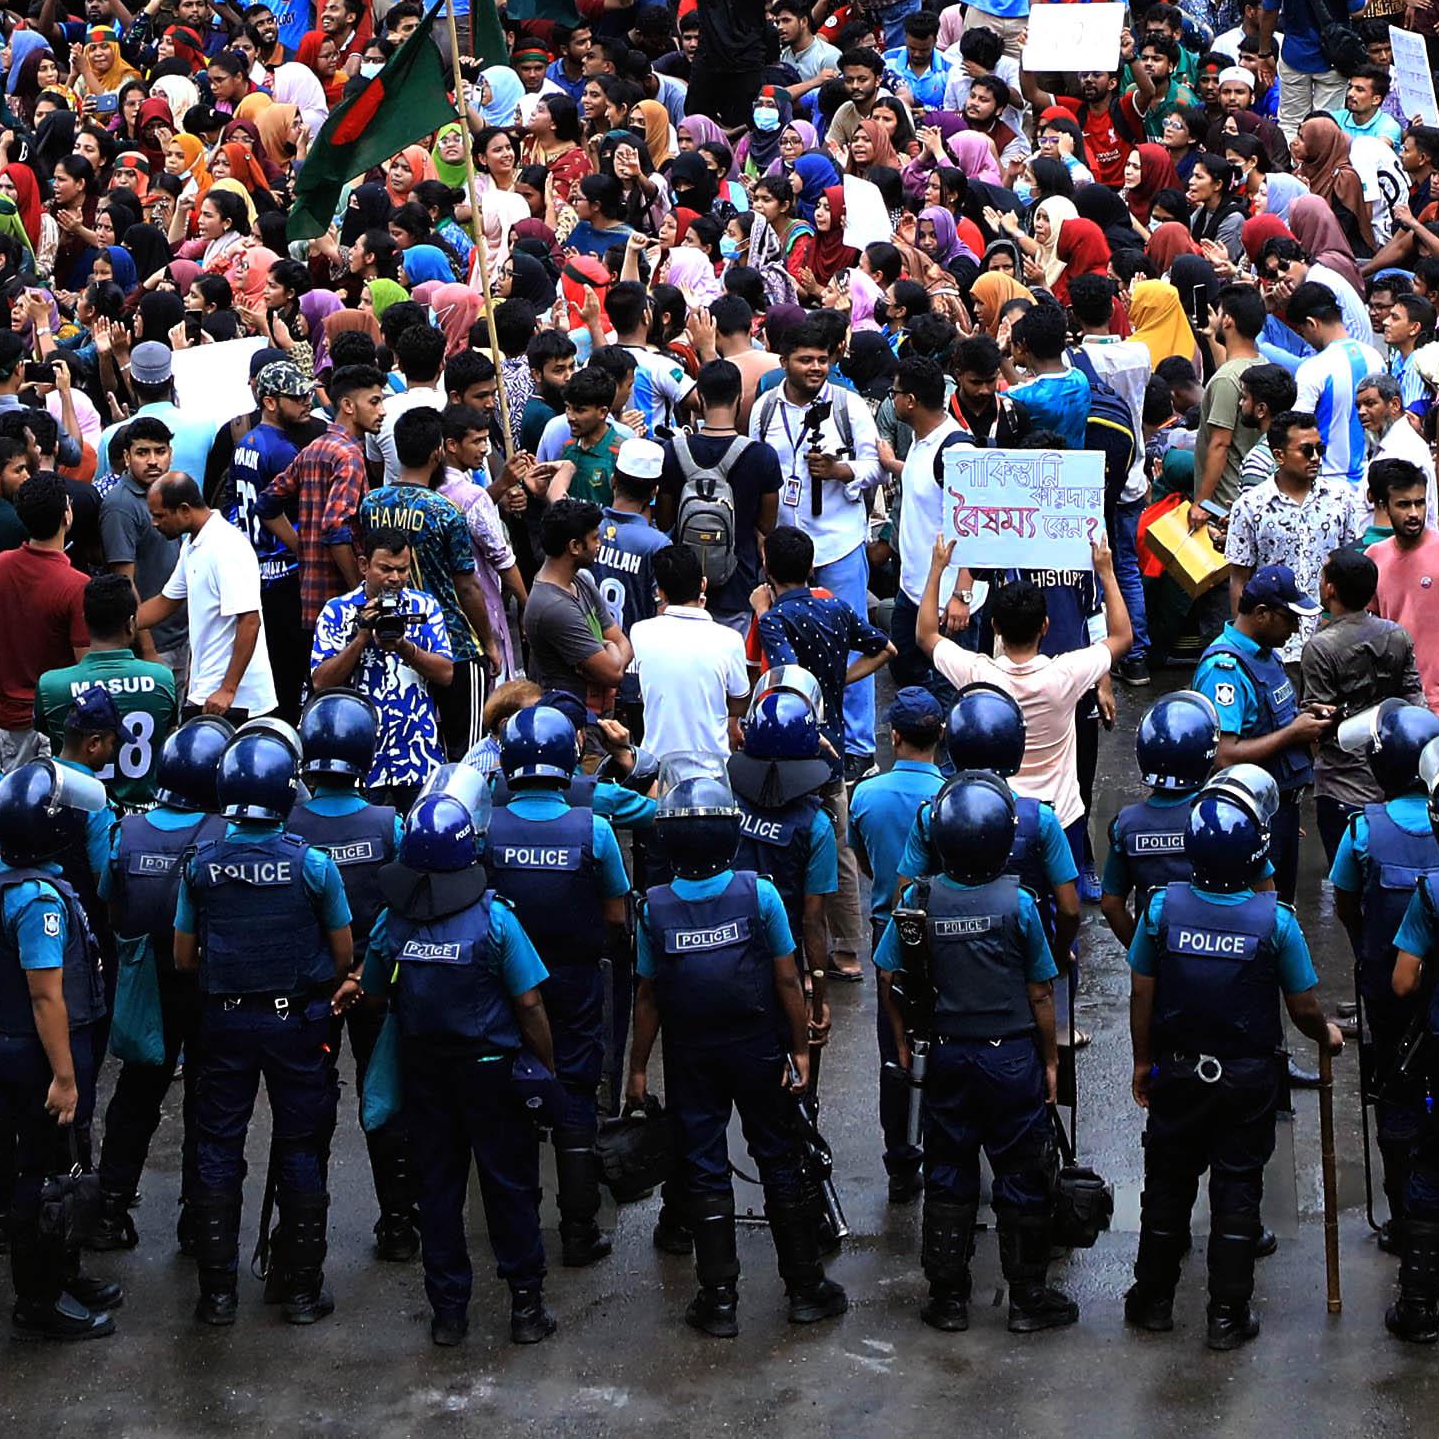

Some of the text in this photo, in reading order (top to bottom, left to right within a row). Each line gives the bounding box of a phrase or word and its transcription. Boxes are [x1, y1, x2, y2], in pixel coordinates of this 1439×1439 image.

[956, 451, 1062, 488] পাকিস্তানি
[1030, 487, 1102, 509] কায়দায়
[370, 507, 425, 531] HAMID
[948, 486, 1040, 538] বৈষম্য
[594, 545, 641, 574] ULLAH
[1030, 570, 1084, 589] HISTORY
[505, 847, 569, 866] POLICE
[209, 861, 293, 884] POLICE
[682, 927, 733, 946] POLICE
[944, 920, 983, 933] POLICE
[1179, 932, 1246, 954] POLICE
